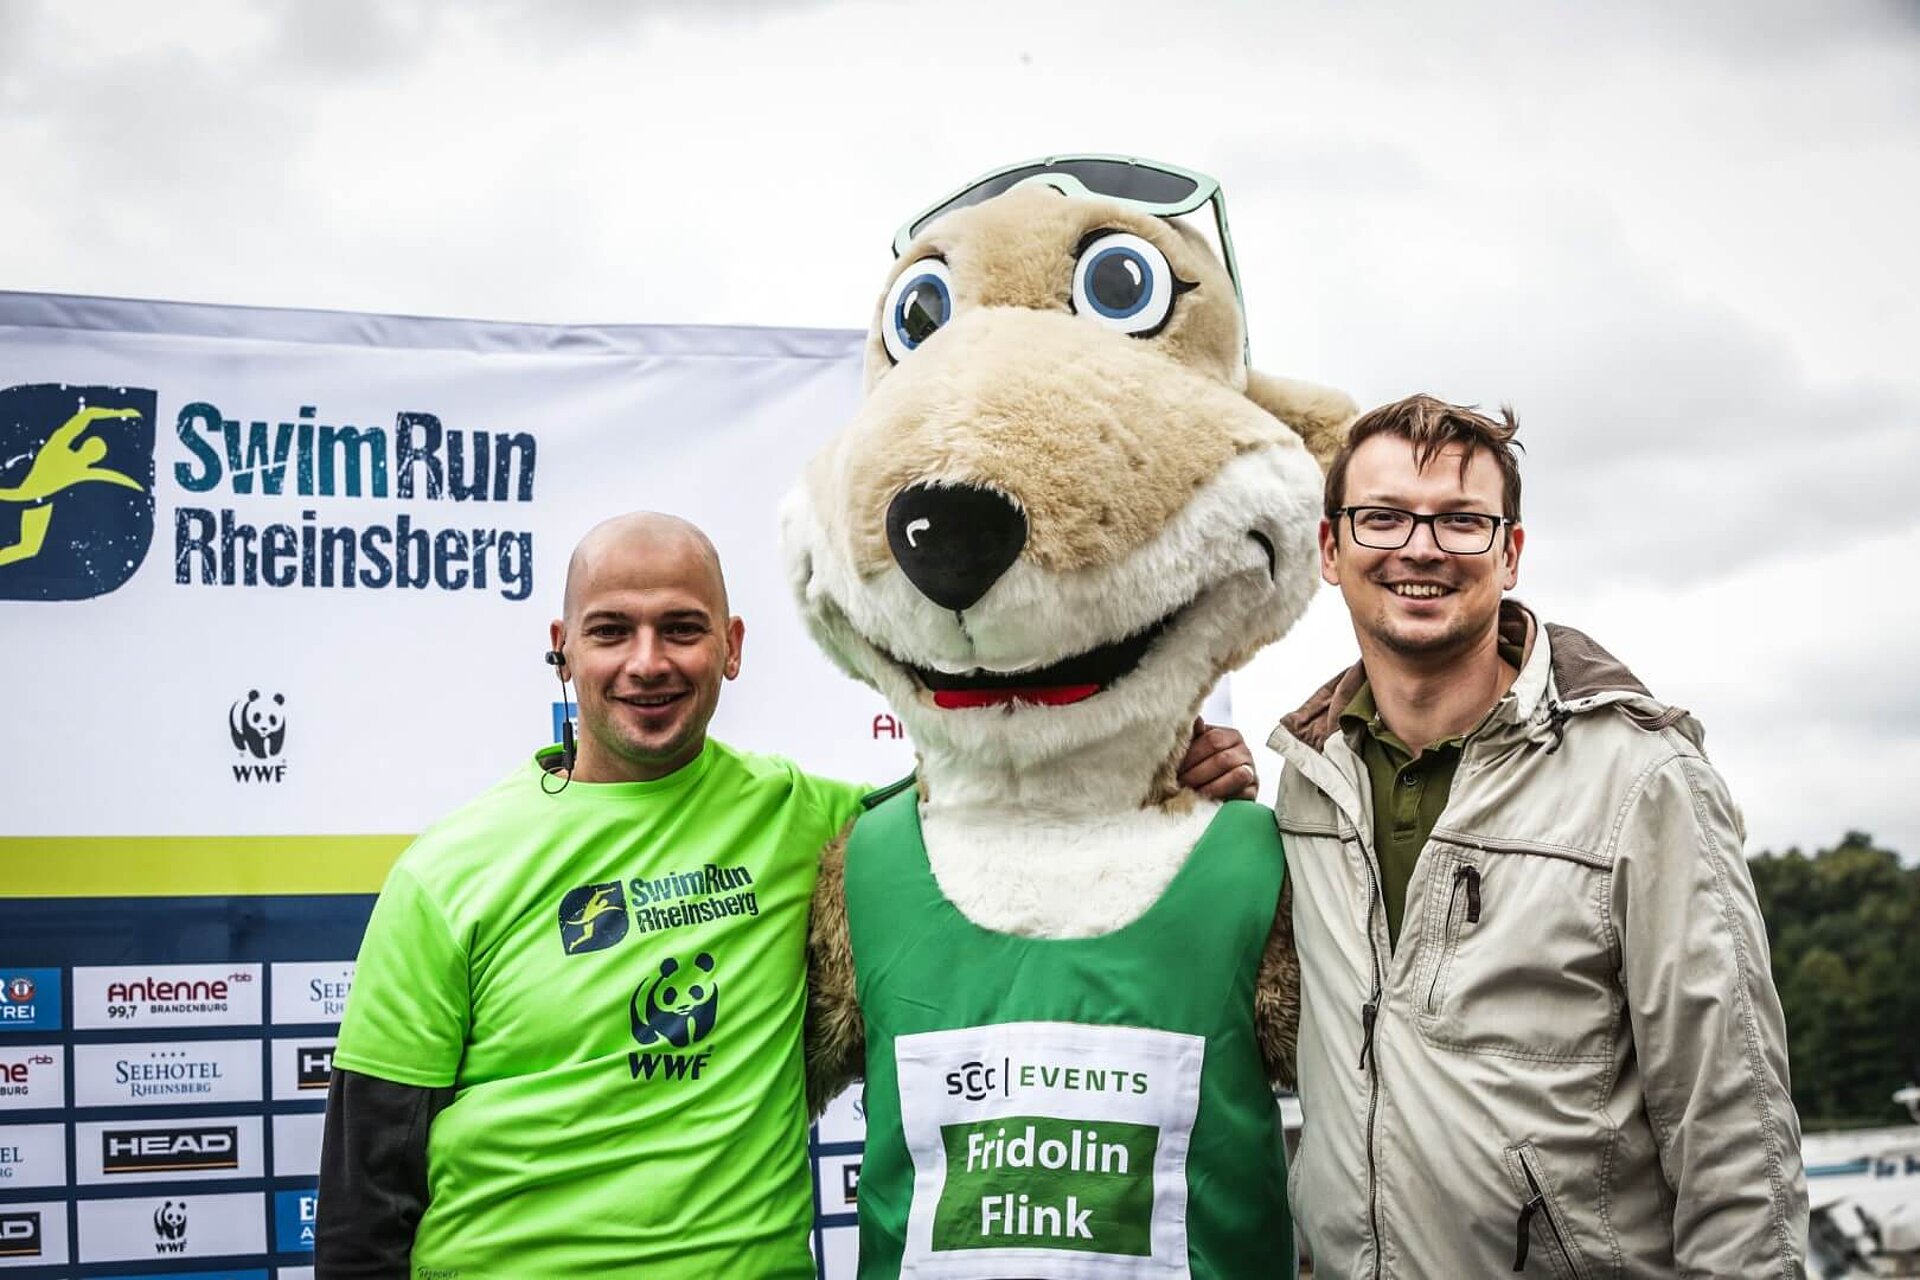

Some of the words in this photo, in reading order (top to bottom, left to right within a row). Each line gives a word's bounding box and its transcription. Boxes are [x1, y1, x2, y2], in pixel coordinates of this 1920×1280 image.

[175, 402, 536, 502] SwimRun
[175, 508, 533, 600] Rheinsberg
[233, 764, 286, 783] WWF
[629, 863, 753, 907] SwimRun
[635, 892, 759, 934] Rheinsberg
[228, 972, 252, 983] rbb
[108, 1005, 137, 1019] 99,7
[150, 1003, 228, 1013] BRANDENBURG
[628, 1052, 711, 1081] WWF
[1020, 1066, 1148, 1094] EVENTS
[109, 1134, 232, 1157] HEAD
[967, 1126, 1128, 1173] Fridolin
[981, 1193, 1093, 1239] Flink
[155, 1240, 187, 1252] WWF
